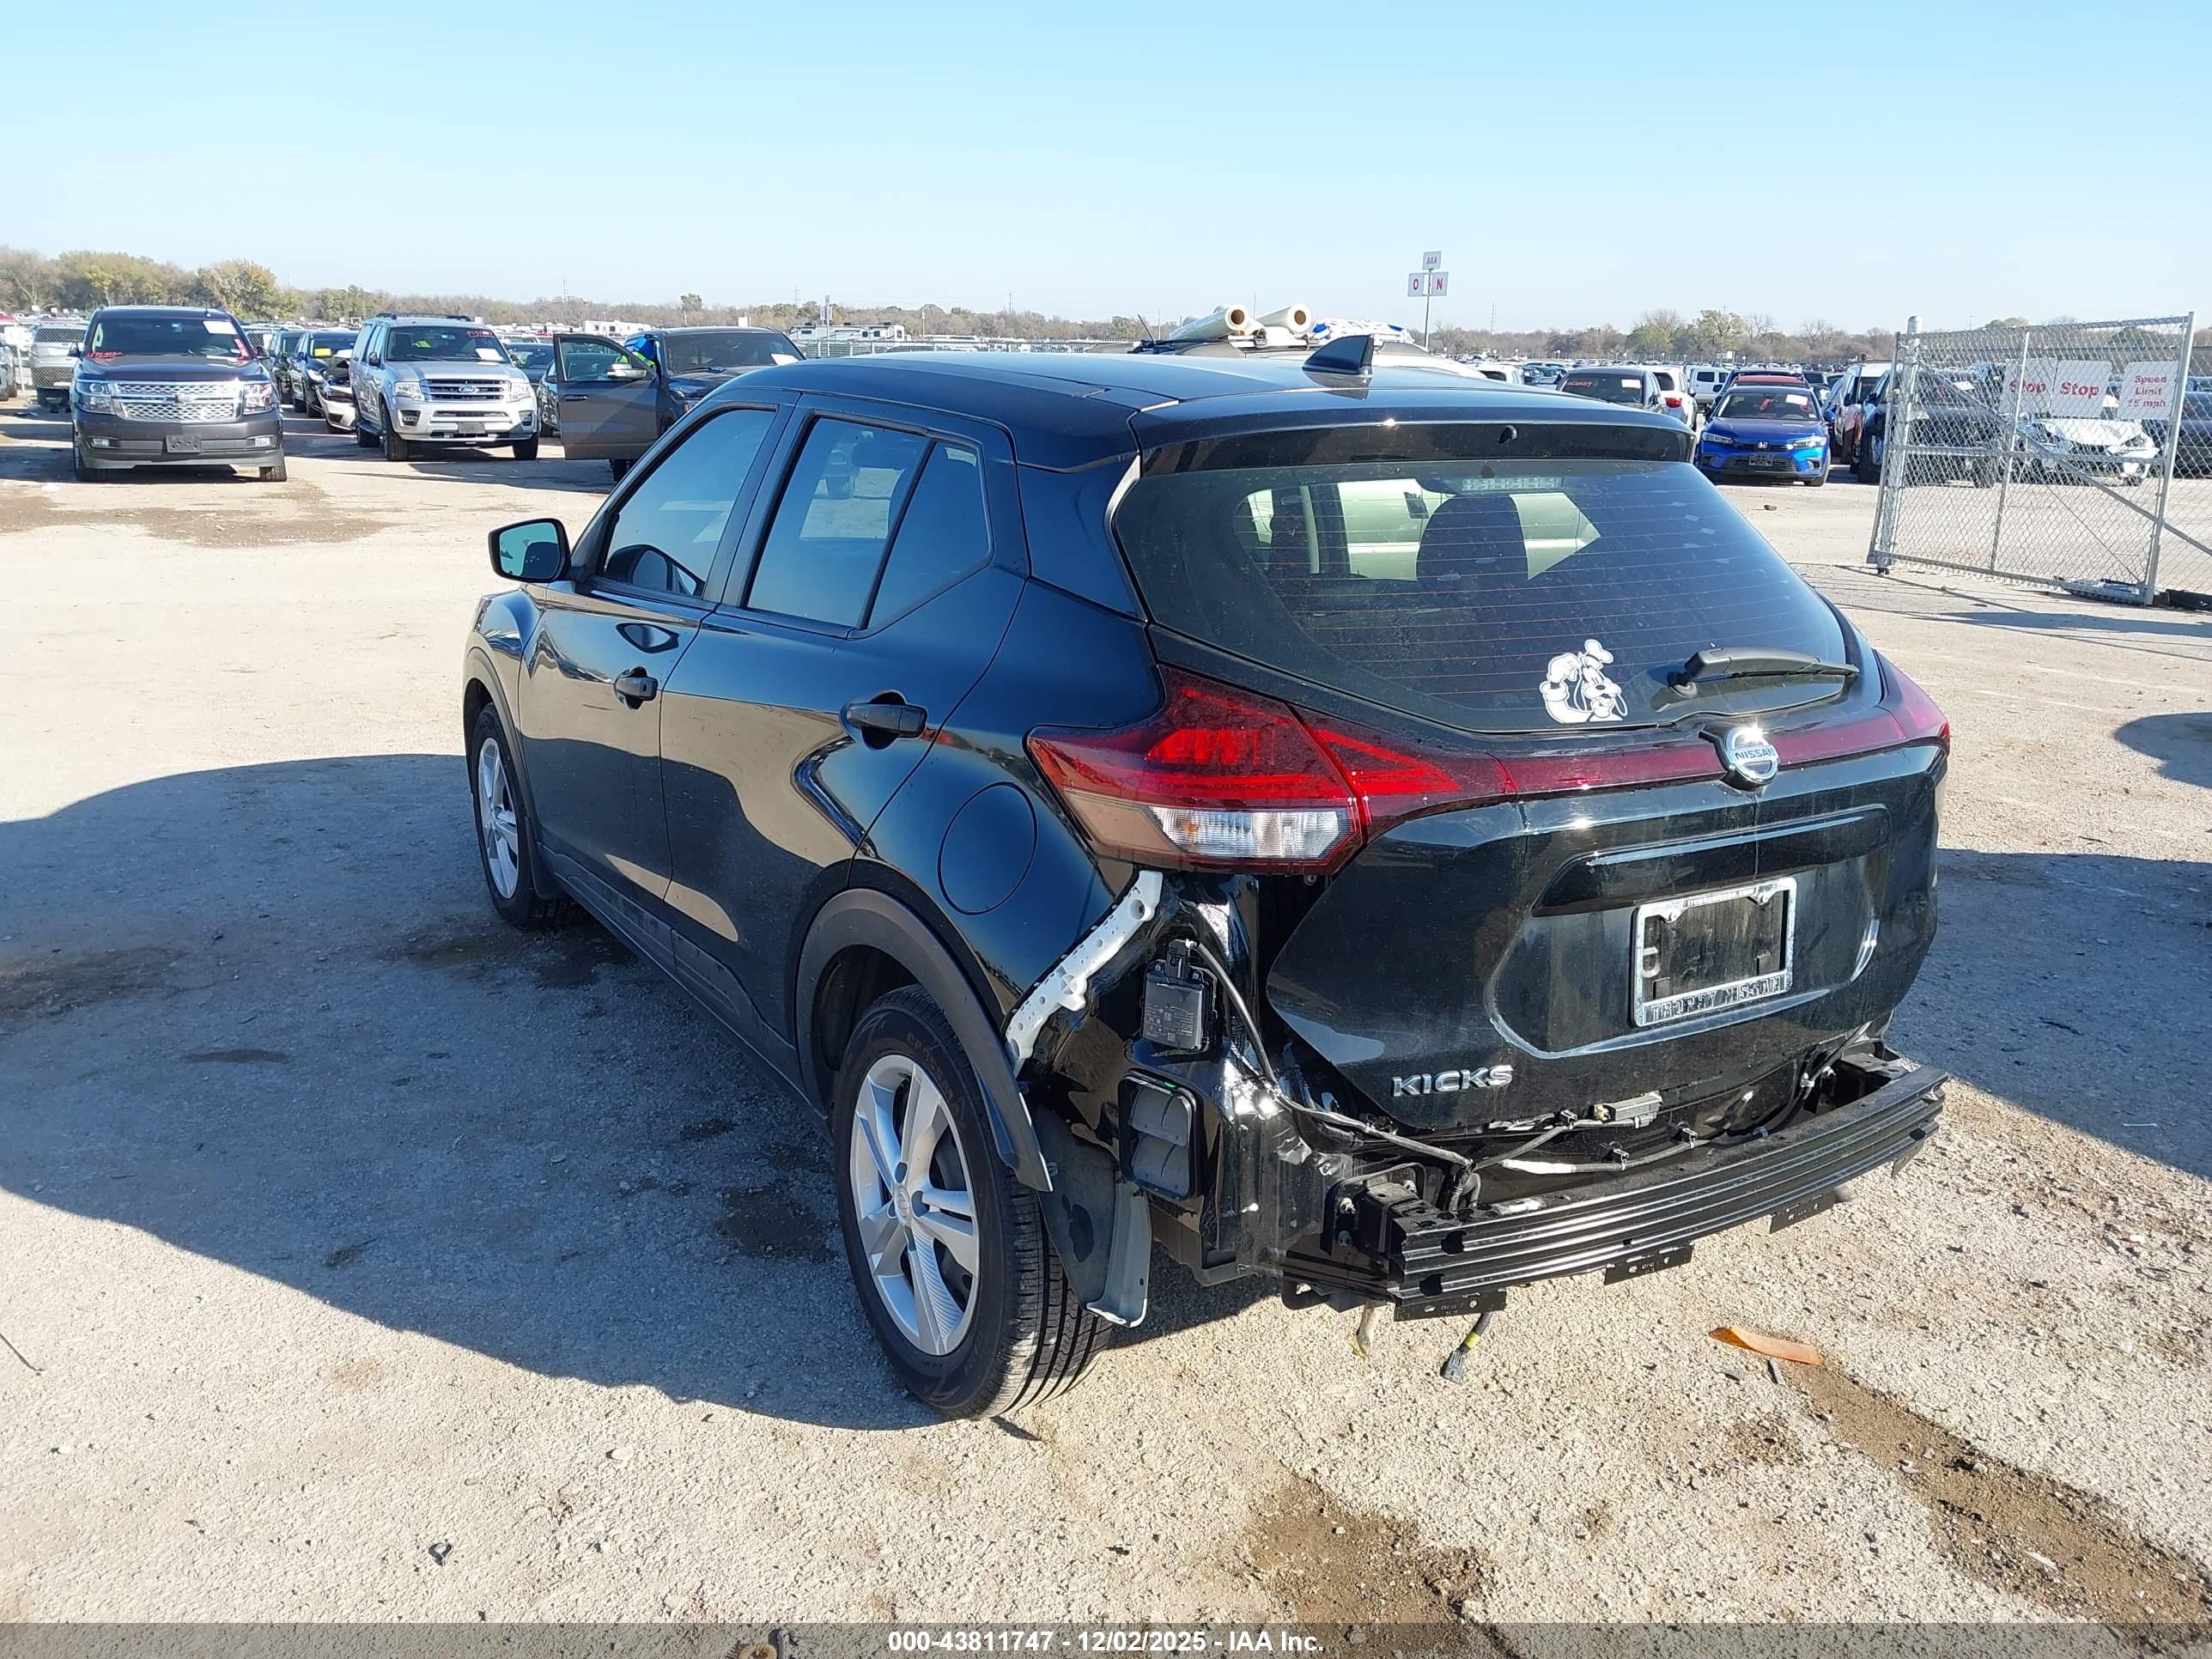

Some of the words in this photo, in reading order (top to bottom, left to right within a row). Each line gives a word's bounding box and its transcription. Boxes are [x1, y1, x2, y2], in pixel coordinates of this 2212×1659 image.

[1436, 277, 1443, 290] N
[2134, 374, 2167, 385] Speed
[2061, 381, 2100, 398] Stop
[2143, 399, 2166, 409] mph
[1735, 746, 1776, 760] NISSAN
[1650, 990, 1718, 1022] TROPHY
[1722, 975, 1783, 1005] NISSAN
[1392, 1064, 1515, 1097] KICKS
